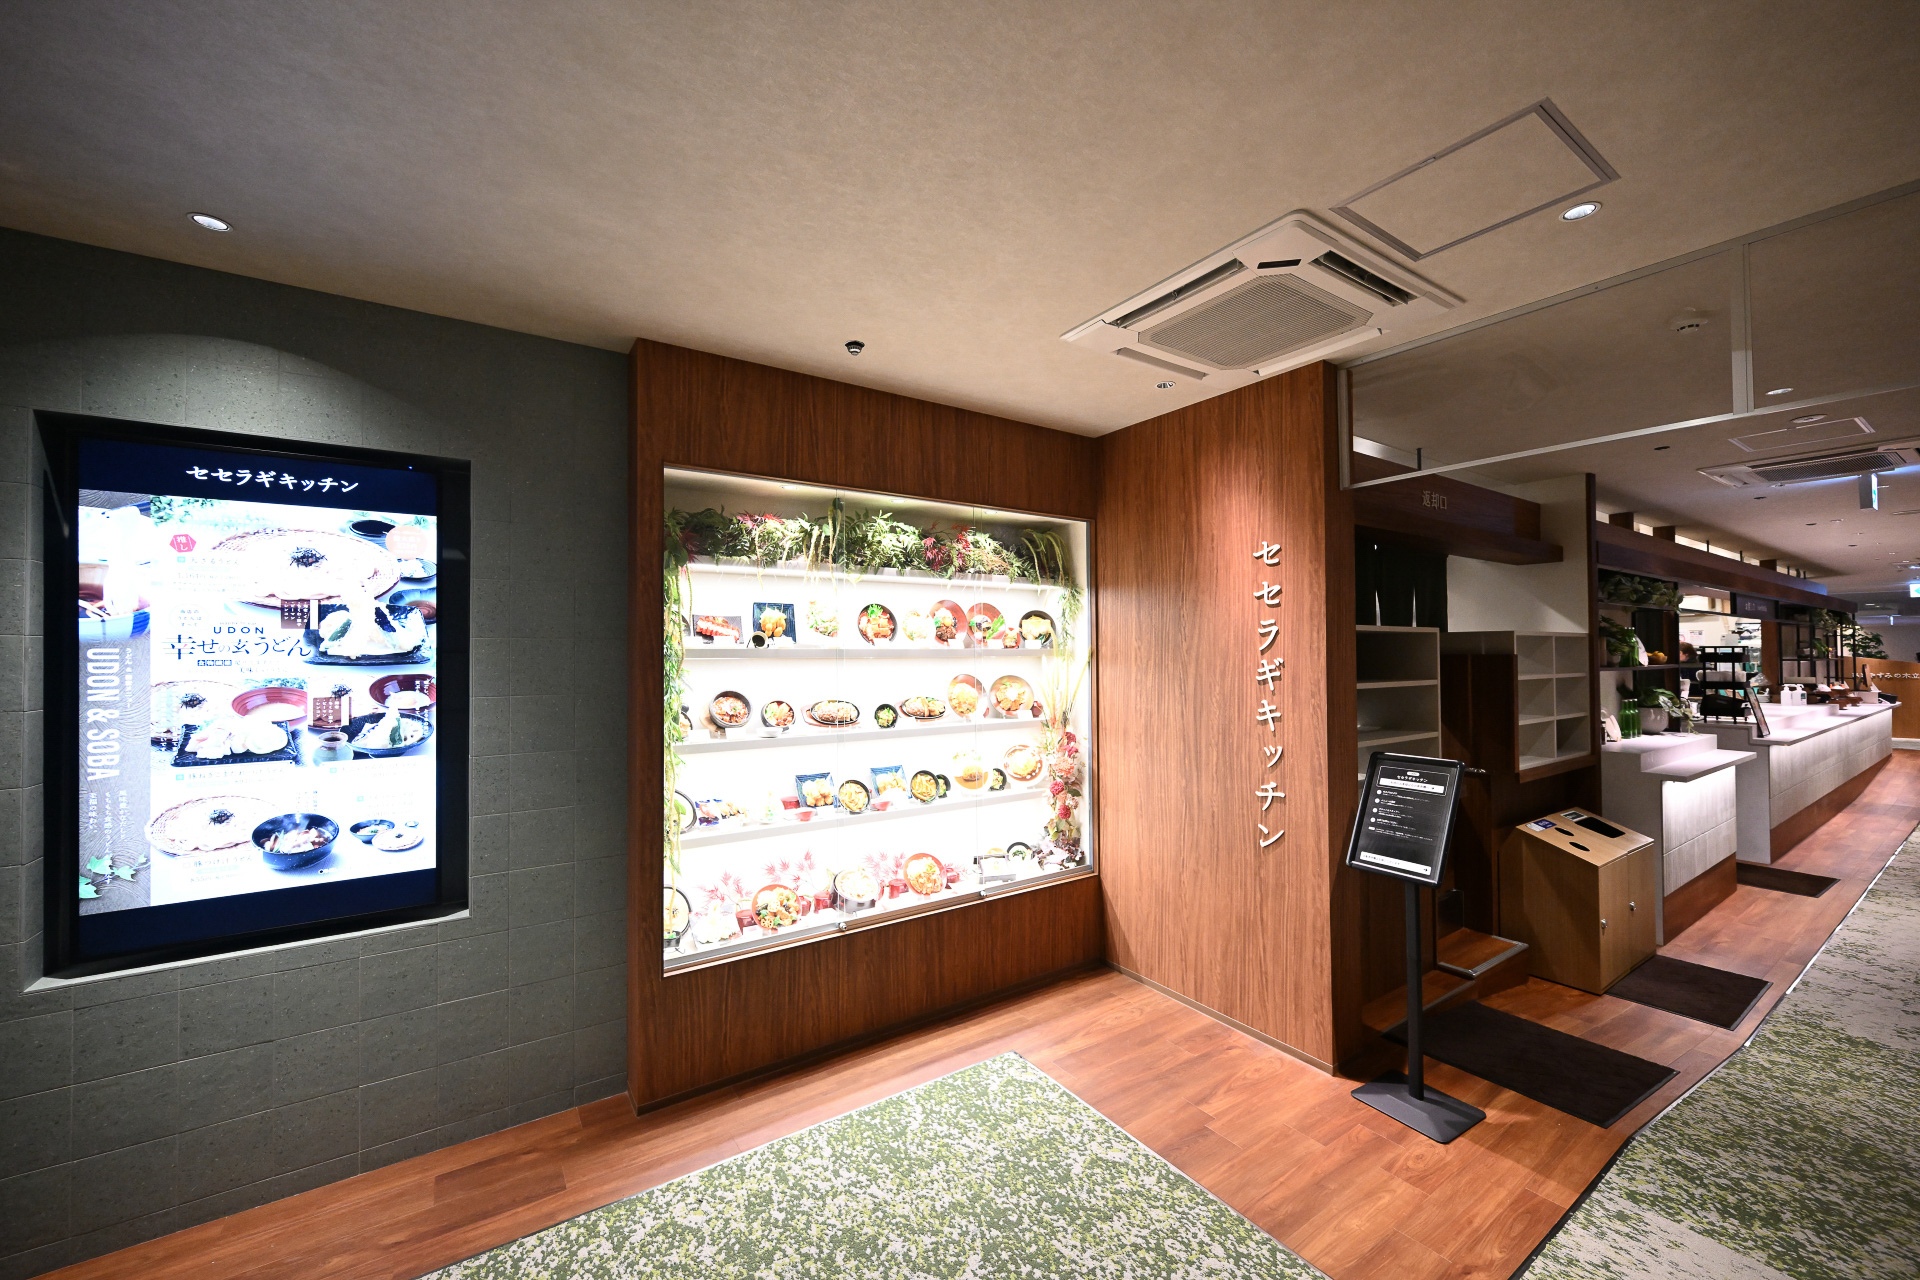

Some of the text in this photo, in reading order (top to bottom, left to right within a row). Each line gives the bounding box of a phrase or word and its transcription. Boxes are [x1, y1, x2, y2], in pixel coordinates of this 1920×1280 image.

[186, 464, 359, 493] セセラギキッチン
[1421, 490, 1448, 510] 返却口
[213, 626, 264, 635] UDON
[162, 634, 312, 661] 幸せの玄うどん
[1253, 540, 1286, 848] セセラギキッチン
[86, 647, 120, 781] UDON & SOBA
